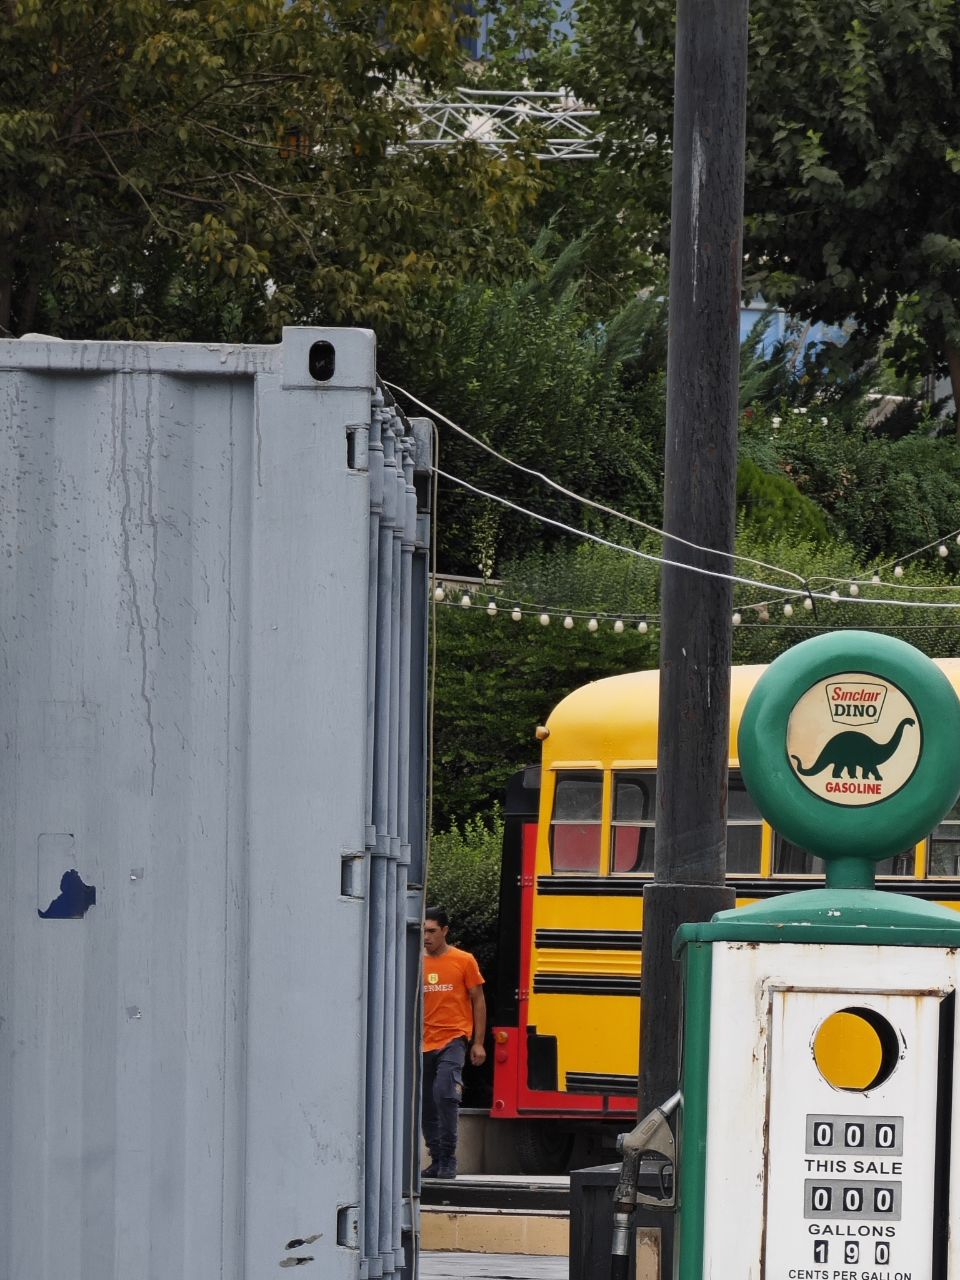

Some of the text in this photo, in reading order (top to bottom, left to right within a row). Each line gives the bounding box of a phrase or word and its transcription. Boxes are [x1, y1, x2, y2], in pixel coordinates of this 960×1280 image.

[831, 686, 882, 703] Sinclair
[833, 704, 878, 719] DINO
[825, 781, 882, 796] GASOLINE
[424, 984, 454, 993] ERMES
[804, 1159, 903, 1175] THIS SALE
[808, 1223, 896, 1238] GALLONS
[788, 1269, 829, 1280] CENTS
[833, 1270, 857, 1280] PER
